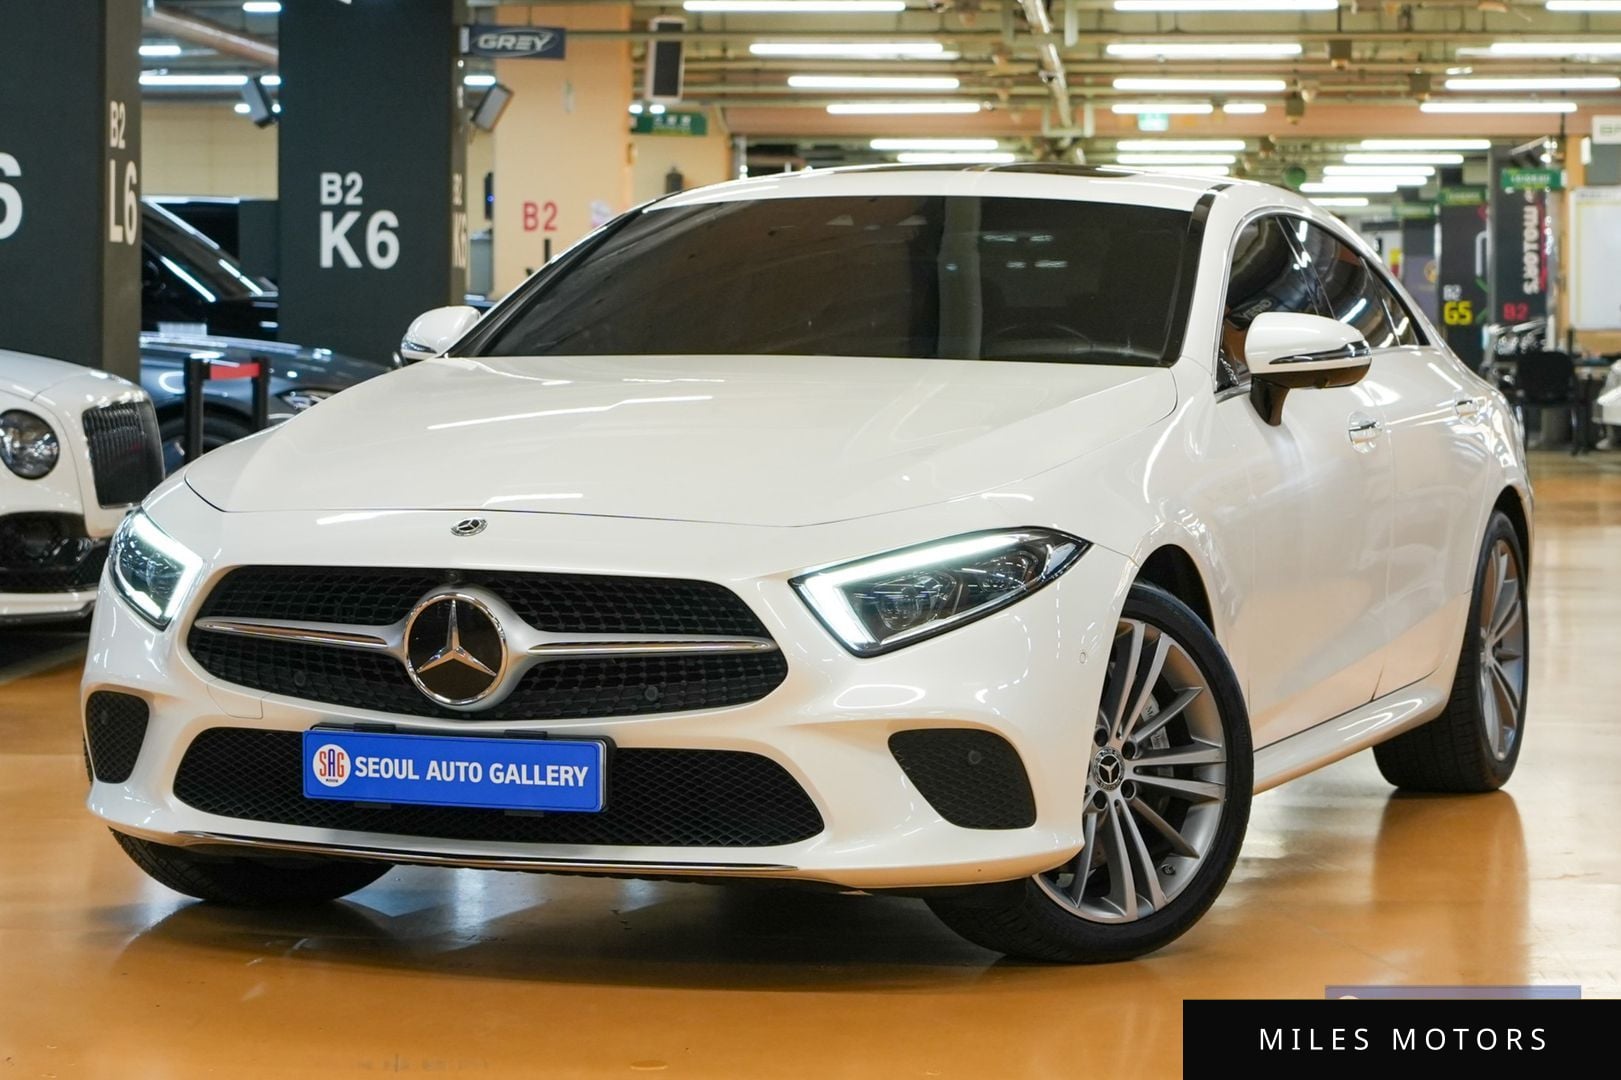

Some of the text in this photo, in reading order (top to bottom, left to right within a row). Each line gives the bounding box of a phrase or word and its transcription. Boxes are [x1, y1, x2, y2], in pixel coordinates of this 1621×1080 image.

[477, 32, 553, 52] GREY
[110, 101, 126, 149] B2
[109, 159, 138, 245] L6
[320, 171, 363, 205] B2
[523, 202, 558, 231] B2
[320, 210, 400, 269] K6
[319, 748, 345, 777] SAG
[354, 756, 589, 787] SEOUL AUTO GALLERY
